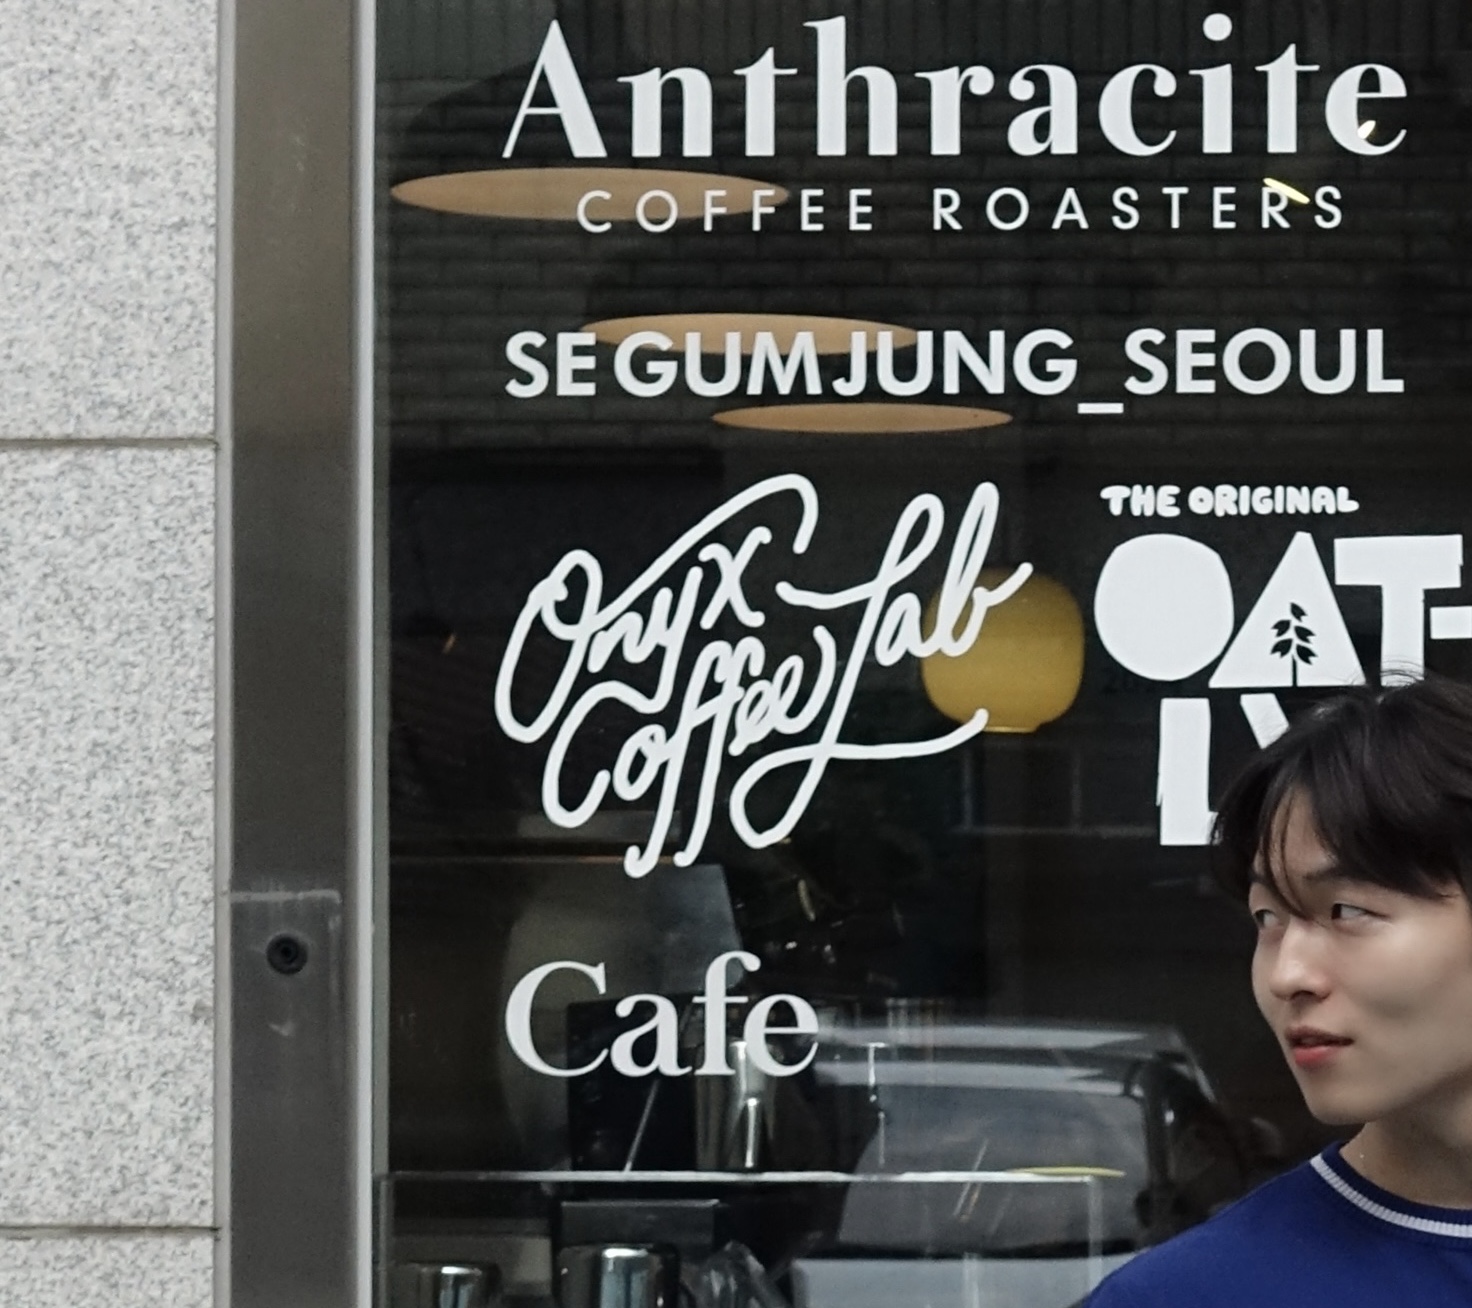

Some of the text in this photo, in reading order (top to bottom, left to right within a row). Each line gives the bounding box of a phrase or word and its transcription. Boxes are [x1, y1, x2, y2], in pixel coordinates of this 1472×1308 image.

[502, 13, 1407, 158] Anthracite
[577, 185, 1343, 233] COFFEE ROASTERS
[1100, 484, 1360, 517] THE ORIGINAL
[495, 473, 819, 744] Onyx
[541, 625, 837, 878] Coffee
[1156, 692, 1291, 846] L
[504, 951, 820, 1077] Cafe
